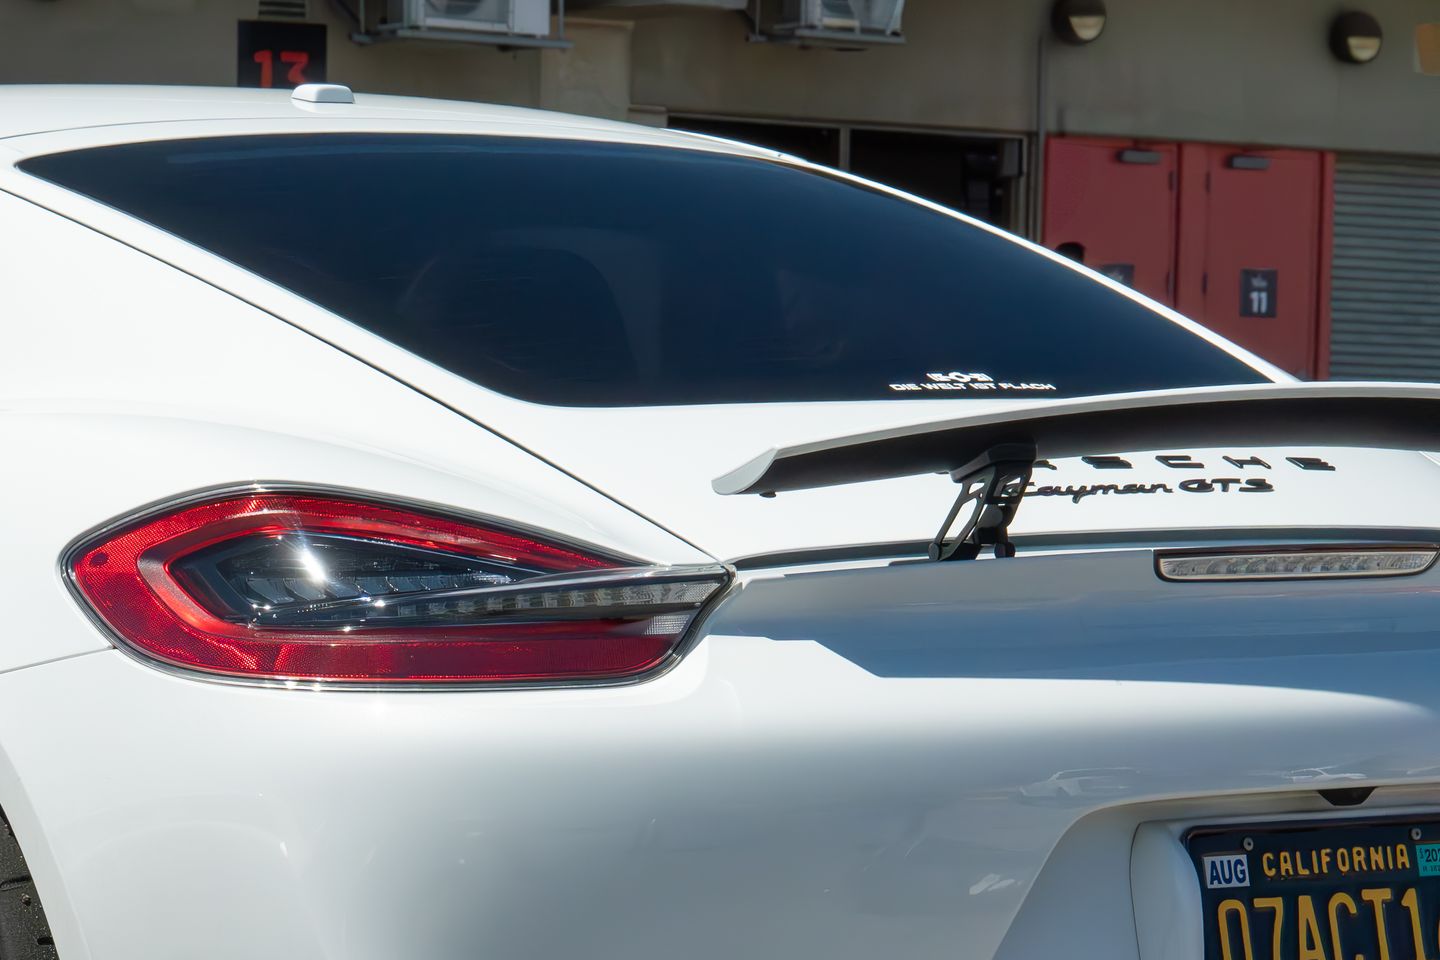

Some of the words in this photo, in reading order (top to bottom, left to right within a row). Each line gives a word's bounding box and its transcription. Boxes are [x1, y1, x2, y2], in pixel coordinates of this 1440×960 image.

[1249, 291, 1268, 314] 11
[889, 383, 922, 391] DIE
[969, 382, 997, 390] IST
[998, 382, 1057, 390] FLACH
[1033, 455, 1336, 471] SCHE
[1178, 477, 1276, 493] GTS
[1262, 843, 1411, 878] CALIFORNIA
[1209, 858, 1247, 885] AUG
